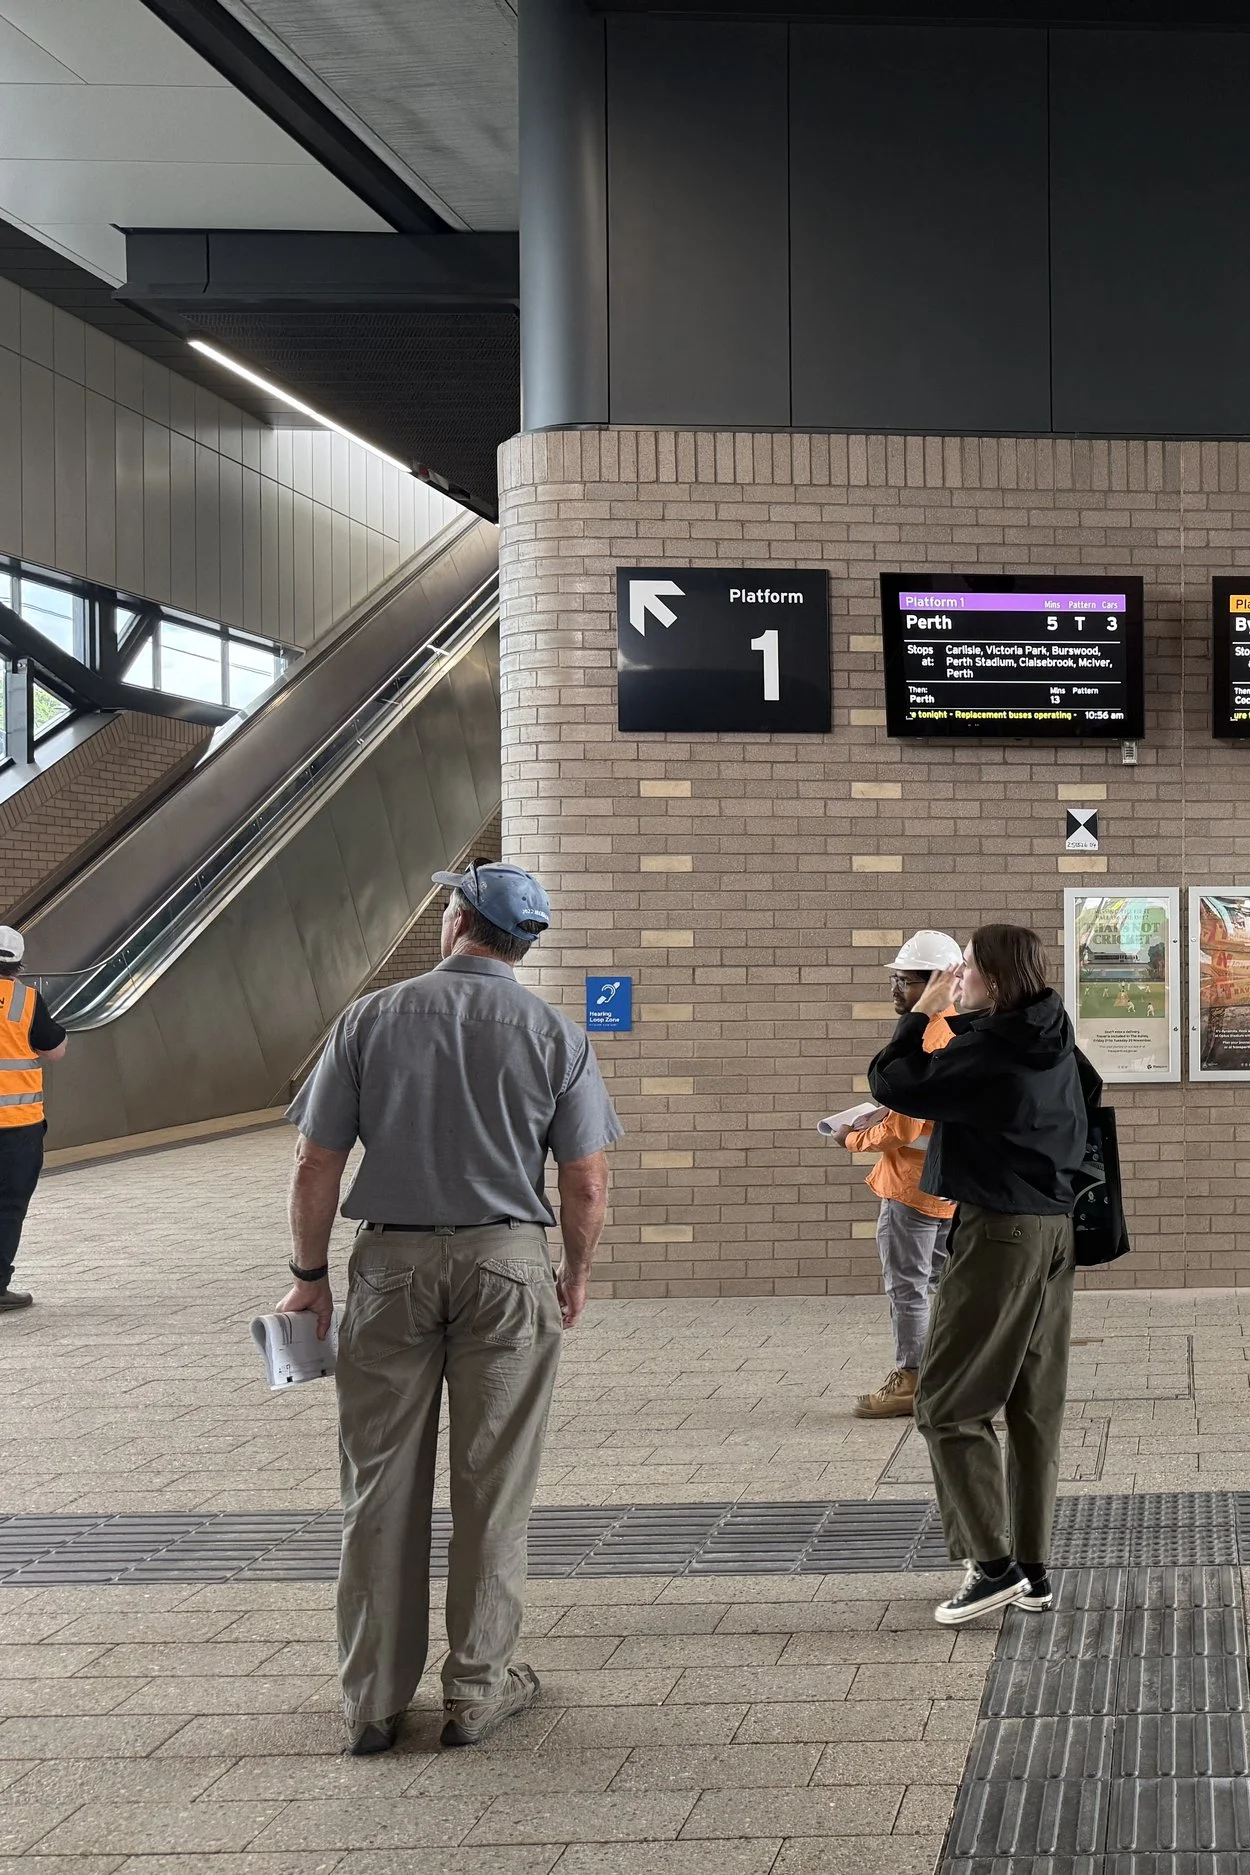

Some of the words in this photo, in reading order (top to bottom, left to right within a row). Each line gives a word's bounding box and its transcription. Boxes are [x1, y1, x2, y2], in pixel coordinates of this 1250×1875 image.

[729, 588, 804, 604] Platform
[905, 597, 958, 607] Platform
[960, 598, 965, 608] 1
[1068, 601, 1096, 609] Pattern
[906, 615, 952, 630] Perth
[1046, 616, 1058, 631] 5
[1074, 617, 1085, 631] T
[1106, 617, 1118, 631] 3
[907, 645, 933, 656] Stops
[946, 645, 983, 655] Carlisle,
[985, 646, 1023, 655] Victoria
[1025, 646, 1050, 656] Park,
[1052, 647, 1101, 656] Burswood,
[750, 629, 780, 701] 1
[922, 657, 935, 666] at:
[946, 658, 973, 667] Perth
[975, 658, 1017, 667] Stadium,
[1019, 658, 1076, 668] Claisebrook,
[1078, 658, 1113, 668] McIver,
[947, 669, 973, 678] Perth
[908, 686, 928, 694] Then:
[1050, 687, 1066, 695] Mins
[1073, 687, 1099, 695] Pattern
[910, 695, 935, 703] Perth
[1050, 696, 1060, 704] 13
[918, 711, 947, 720] tonight
[955, 711, 1007, 720] Replacement
[1009, 711, 1032, 719] buses
[1034, 711, 1072, 720] operating
[1085, 711, 1109, 720] 10:56
[1093, 934, 1153, 945] CRICKET
